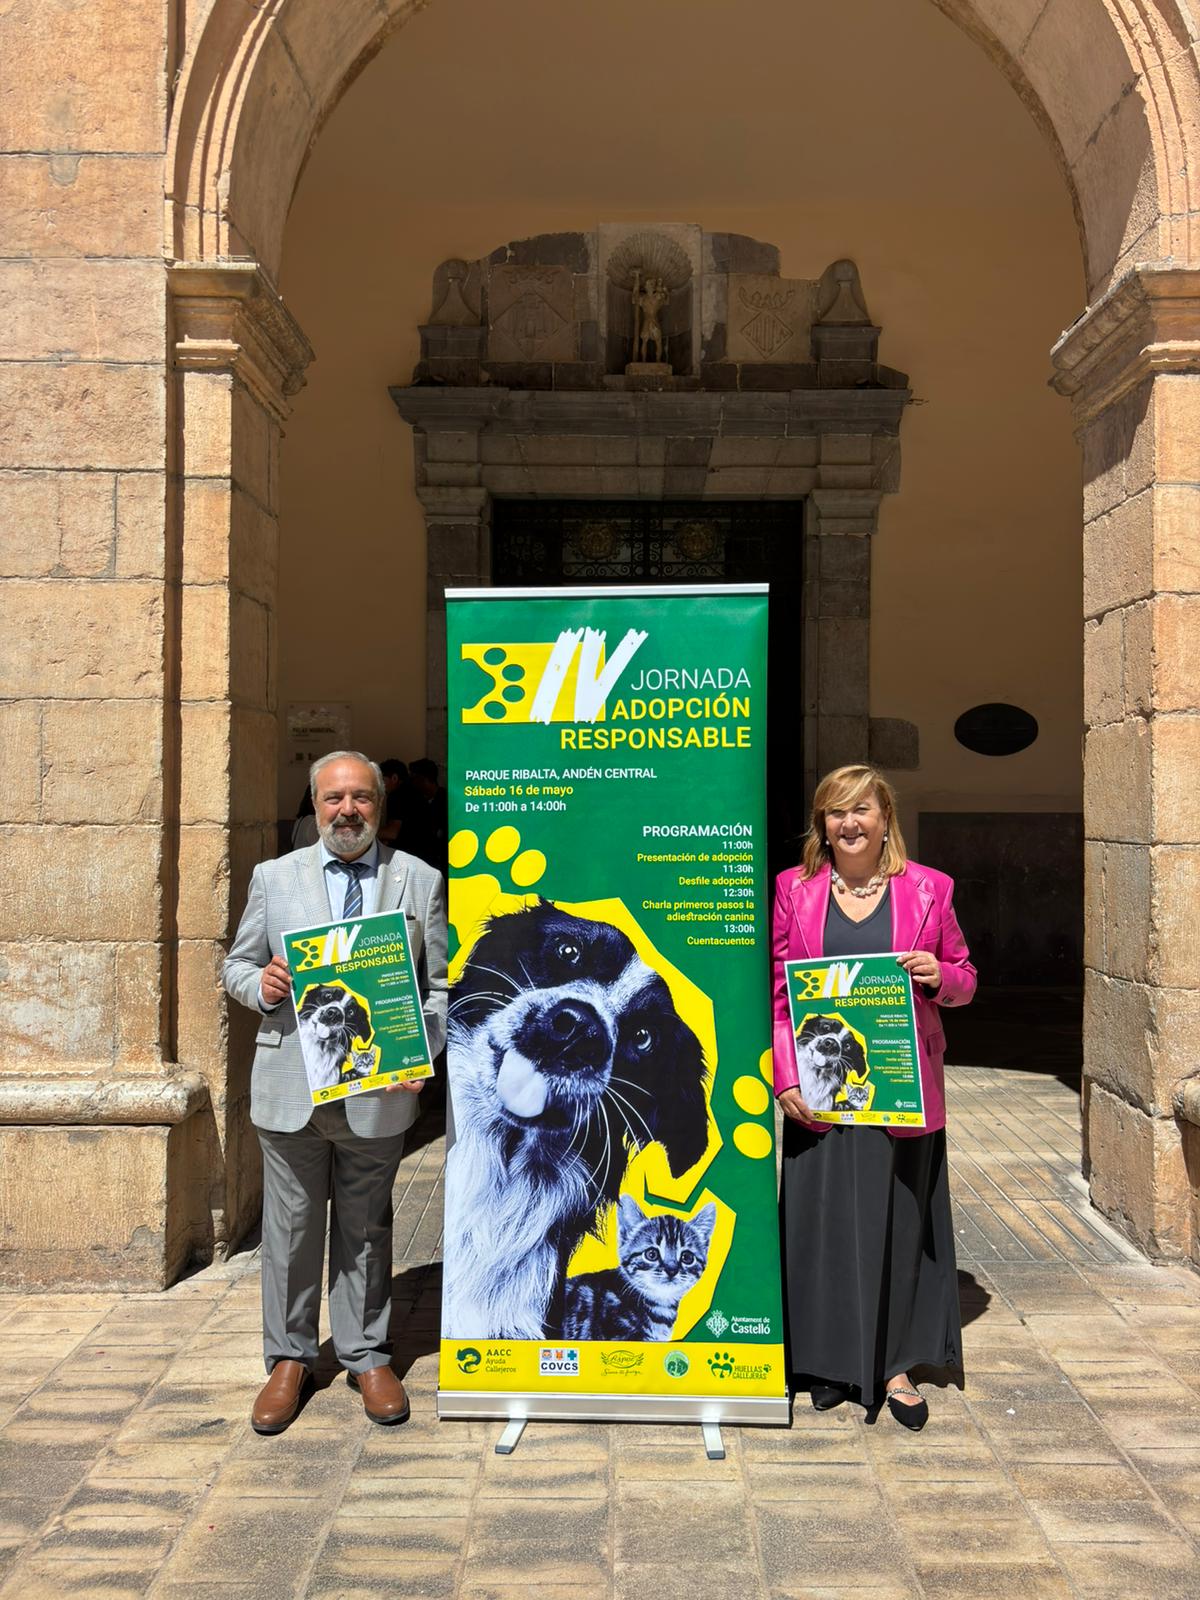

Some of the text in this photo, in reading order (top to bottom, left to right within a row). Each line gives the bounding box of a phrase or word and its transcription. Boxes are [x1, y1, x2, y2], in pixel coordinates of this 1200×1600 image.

[530, 626, 649, 725] IV
[631, 668, 752, 691] JORNADA
[612, 694, 750, 720] ADOPCIÓN
[560, 726, 752, 750] RESPONSABLE
[466, 766, 657, 781] PARQUE RIBALTA, ANDÉN CENTRAL
[464, 784, 574, 798] Sábado 16 de mayo
[465, 800, 566, 812] De 11:00h a 14:00h
[642, 822, 752, 837] PROGRAMACIÓN
[722, 841, 753, 850] 11:00h
[637, 853, 754, 863] Presentación de adopción
[722, 864, 754, 873] 11:30h
[678, 876, 754, 886] Desfile adopción
[723, 888, 754, 897] 12:30h
[642, 900, 672, 909] Charla
[673, 900, 714, 911] primeros
[716, 902, 744, 910] pasos
[666, 912, 754, 921] adiestración canina
[724, 924, 755, 933] 13:00h
[321, 924, 362, 966] IV
[358, 932, 402, 948] JORNADA
[686, 936, 756, 946] Cuentacuentos
[352, 942, 404, 960] ADOPCIÓN
[336, 952, 406, 974] RESPONSABLE
[822, 962, 864, 998] IV
[858, 975, 904, 985] JORNADA
[853, 984, 905, 996] ADOPCIÓN
[834, 996, 906, 1008] RESPONSABLE
[731, 1322, 770, 1335] Castelló
[485, 1366, 516, 1374] Callejeros
[540, 1362, 578, 1371] COVCS
